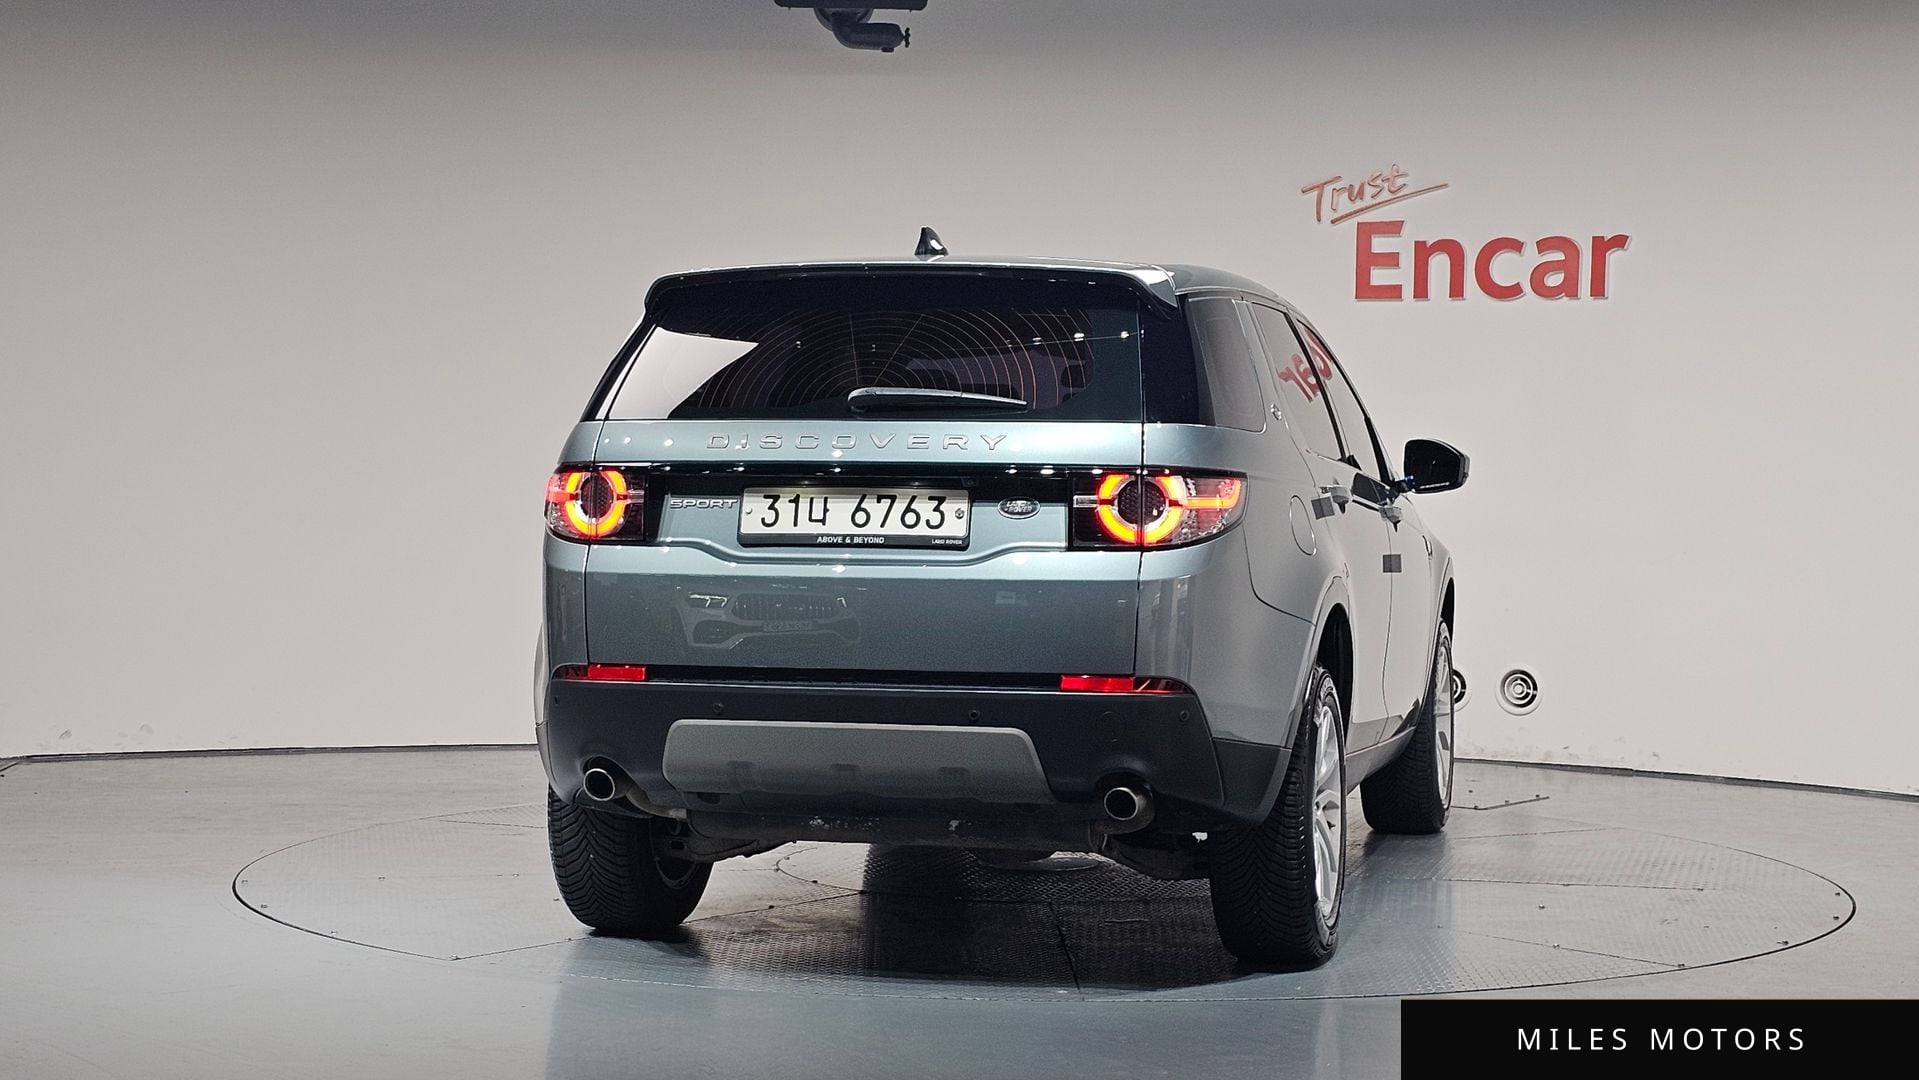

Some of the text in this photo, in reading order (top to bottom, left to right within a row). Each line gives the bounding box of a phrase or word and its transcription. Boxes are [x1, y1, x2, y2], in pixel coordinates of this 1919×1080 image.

[1302, 163, 1409, 223] Trust
[1354, 220, 1630, 301] Encar
[706, 432, 1008, 451] DISCOVERY
[669, 499, 738, 510] SPORT
[850, 494, 946, 530] 6763
[816, 535, 885, 544] ABOVE & BEYOND
